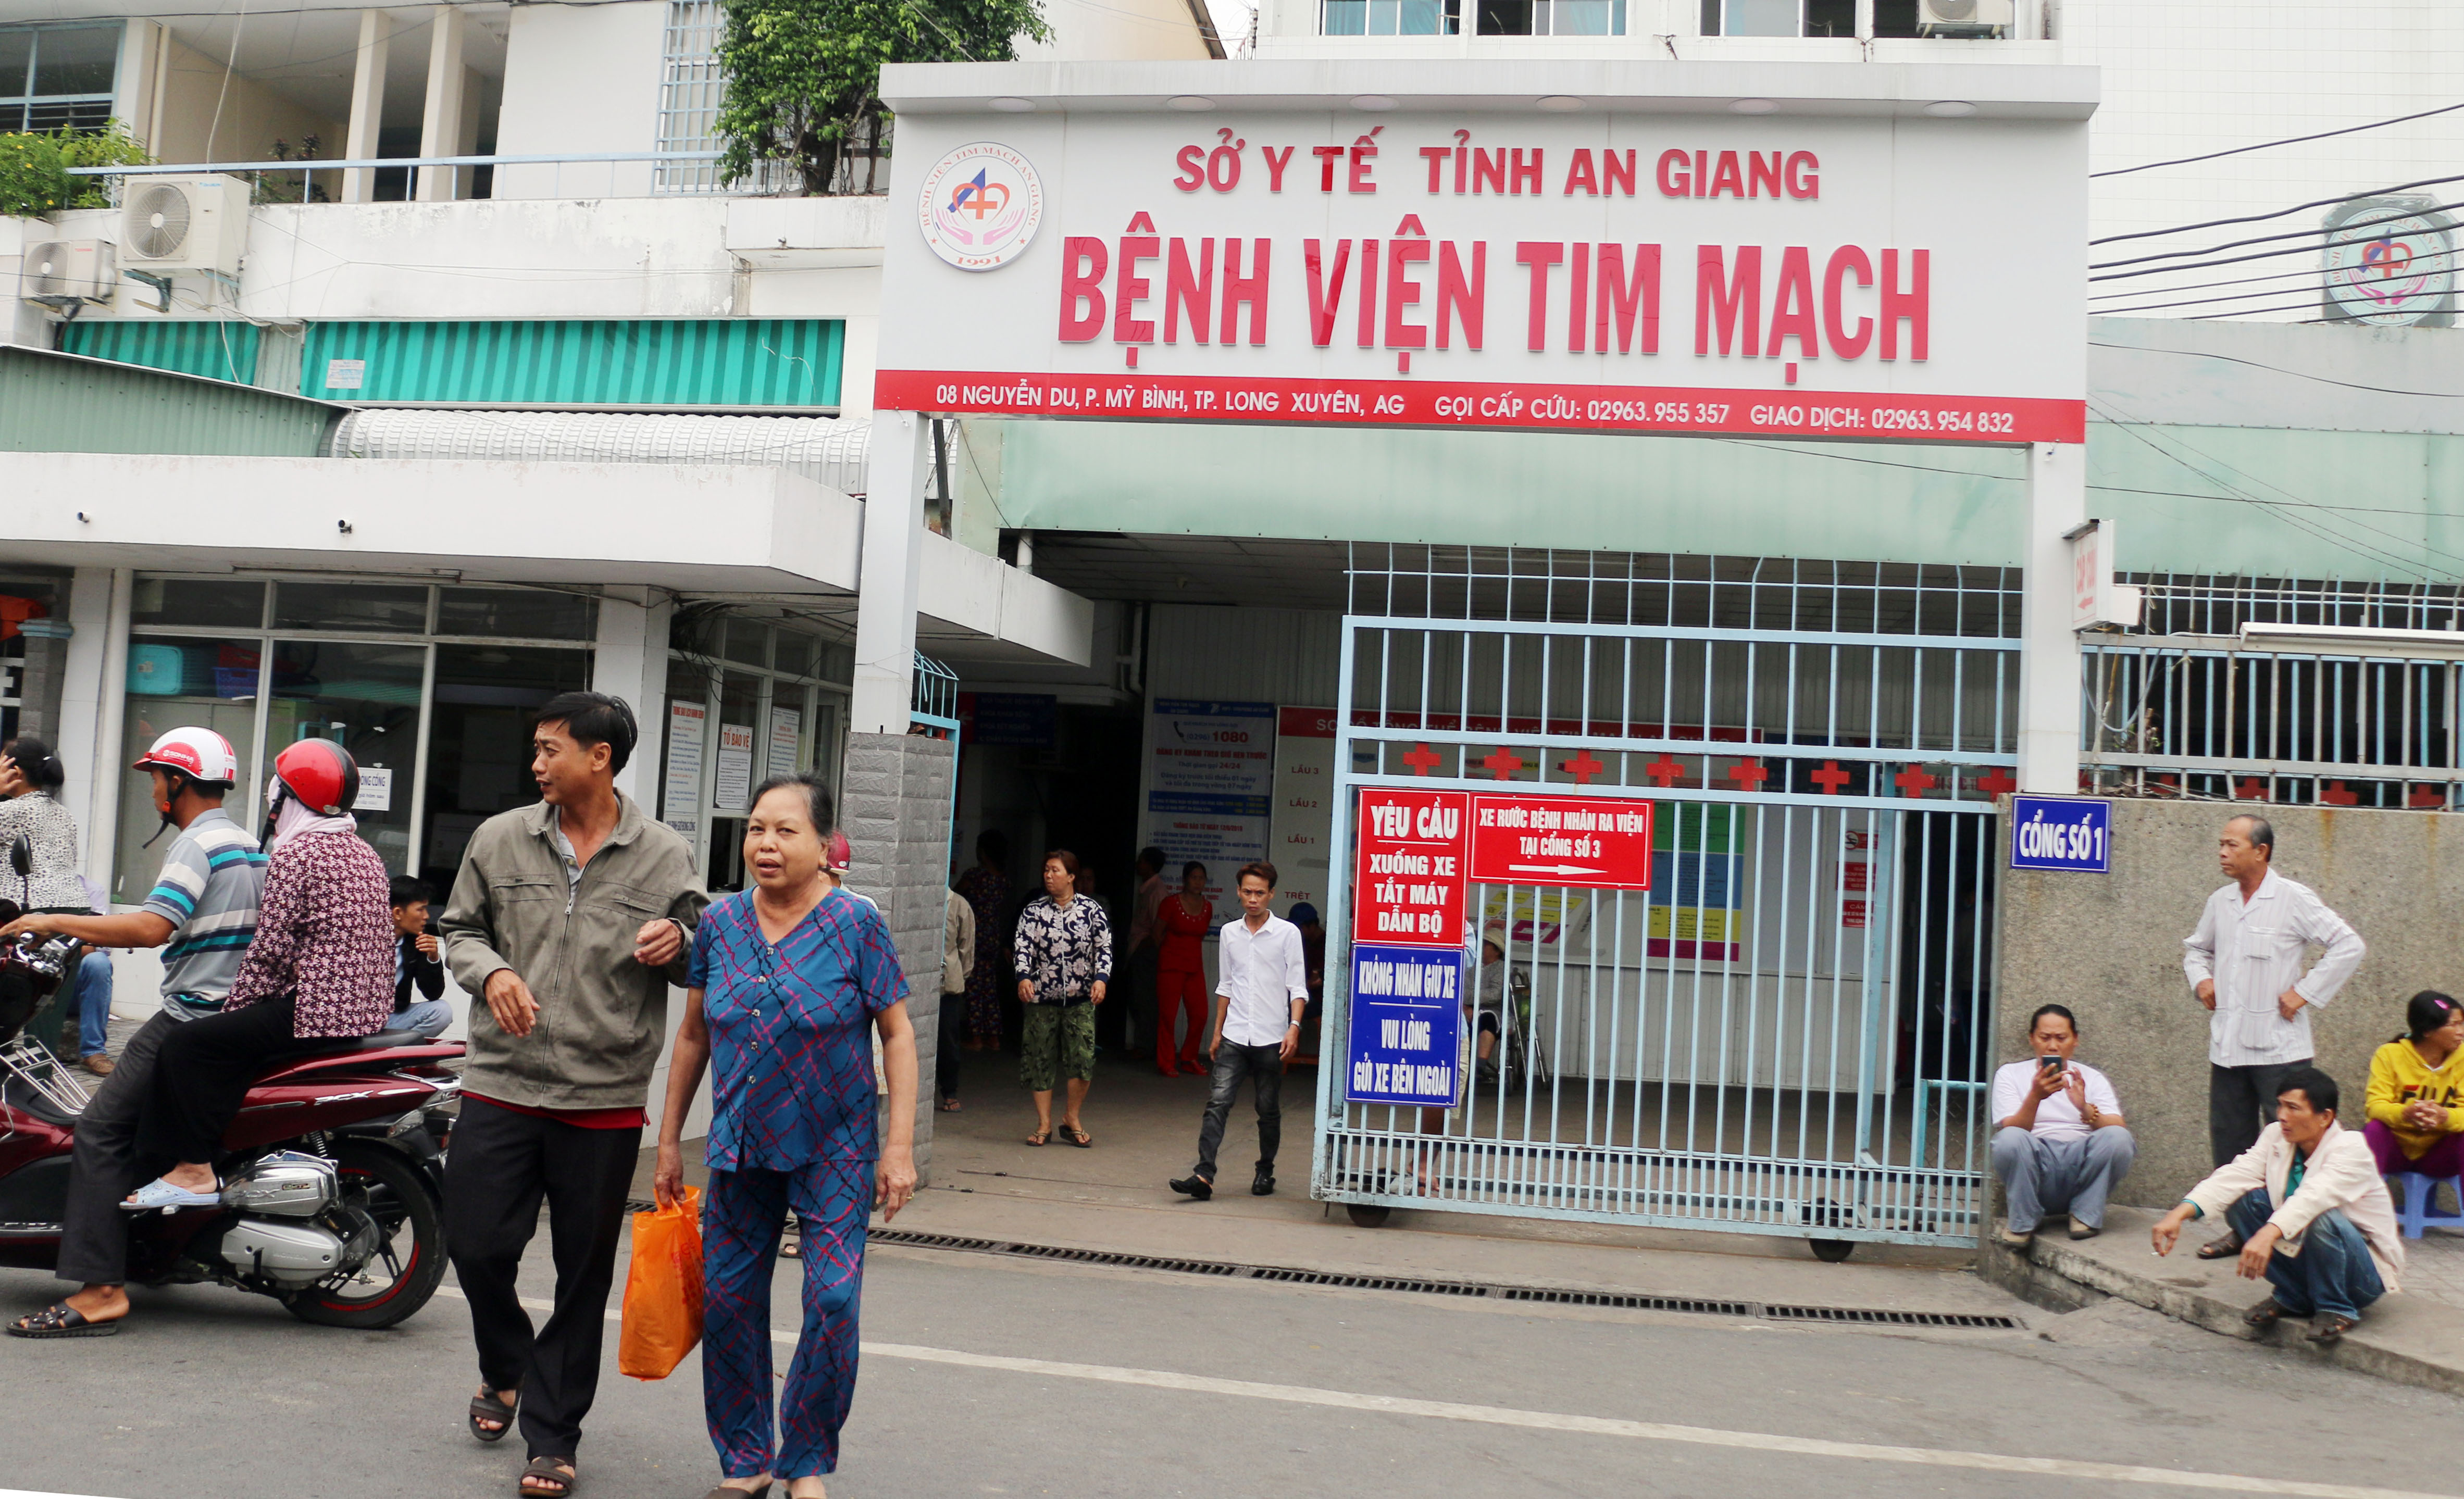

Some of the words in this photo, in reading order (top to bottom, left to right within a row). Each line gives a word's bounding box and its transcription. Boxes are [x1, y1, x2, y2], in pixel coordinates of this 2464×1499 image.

[1174, 128, 1245, 192] SỞ
[1263, 146, 1295, 191] Y
[1313, 127, 1383, 192] TẾ
[1420, 130, 1543, 194] TỈNH
[1565, 149, 1636, 195] AN
[1657, 149, 1819, 198] GIANG
[955, 147, 978, 160] TIM
[1019, 166, 1034, 181] AN
[1028, 183, 1040, 227] GIANG
[957, 255, 1001, 266] 1991
[1059, 211, 1271, 366] BỆNH
[1304, 214, 1486, 371] VIỆN
[1516, 242, 1661, 353] TIM
[1695, 245, 1929, 384] MẠCH
[937, 385, 956, 404] 08
[963, 379, 1041, 405] NGUYỄN
[1050, 388, 1079, 409] DU,
[1086, 389, 1099, 406] P.
[1106, 385, 1135, 407] MỸ
[1143, 384, 1187, 411] BÌNH,
[1194, 391, 1216, 409] TP.
[1226, 392, 1278, 411] LONG
[1291, 390, 1364, 416] XUYÊN,
[1374, 395, 1404, 414] AG
[1436, 396, 1472, 420] GỌI
[1481, 391, 1523, 417] CẤP
[1531, 394, 1580, 419] CỨU:
[1588, 401, 1650, 421] 02963.
[1655, 403, 1689, 422] 955
[1695, 403, 1729, 423] 357
[1751, 405, 1803, 426] GIAO
[1811, 407, 1864, 431] DỊCH:
[1872, 409, 1933, 430] 02963.
[1937, 411, 1972, 431] 954
[1977, 413, 2013, 432] 832
[1213, 730, 1249, 743] 1080
[169, 751, 195, 764] SONHA
[1219, 761, 1241, 770] 24/24
[360, 773, 371, 786] ÓNG
[1370, 800, 1410, 838] YÊU
[1417, 797, 1458, 839] CẦU
[1479, 808, 1494, 826] XE
[1530, 807, 1561, 833] BỆNH
[1563, 808, 1596, 831] NHÂN
[1599, 814, 1613, 831] RA
[1617, 811, 1642, 836] VIỆN
[1520, 836, 1538, 859] TẠI
[1540, 831, 1572, 857] CỔNG
[1574, 833, 1591, 857] SỐ
[1592, 840, 1600, 858] 3
[2019, 809, 2067, 859] CỔNG
[2068, 814, 2091, 859] SỐ
[2094, 827, 2103, 861] 1
[1370, 848, 1428, 875] XUỐNG
[1434, 857, 1455, 876] XE
[1374, 877, 1405, 904] TẮT
[1410, 882, 1448, 905] MÁY
[1378, 905, 1414, 932] DẪN
[1419, 910, 1441, 938] BỘ
[1358, 954, 1393, 996] KHÔNG
[1395, 956, 1423, 1004] NHẬN
[1442, 965, 1456, 999] XE
[1382, 1019, 1399, 1048] VUI
[1401, 1014, 1429, 1050] LÒNG
[1353, 1052, 1373, 1092] GỬI
[1375, 1063, 1389, 1092] XE
[1391, 1058, 1414, 1093] BÊN
[1416, 1060, 1450, 1095] NGOÀI
[314, 1090, 374, 1106] PCX
